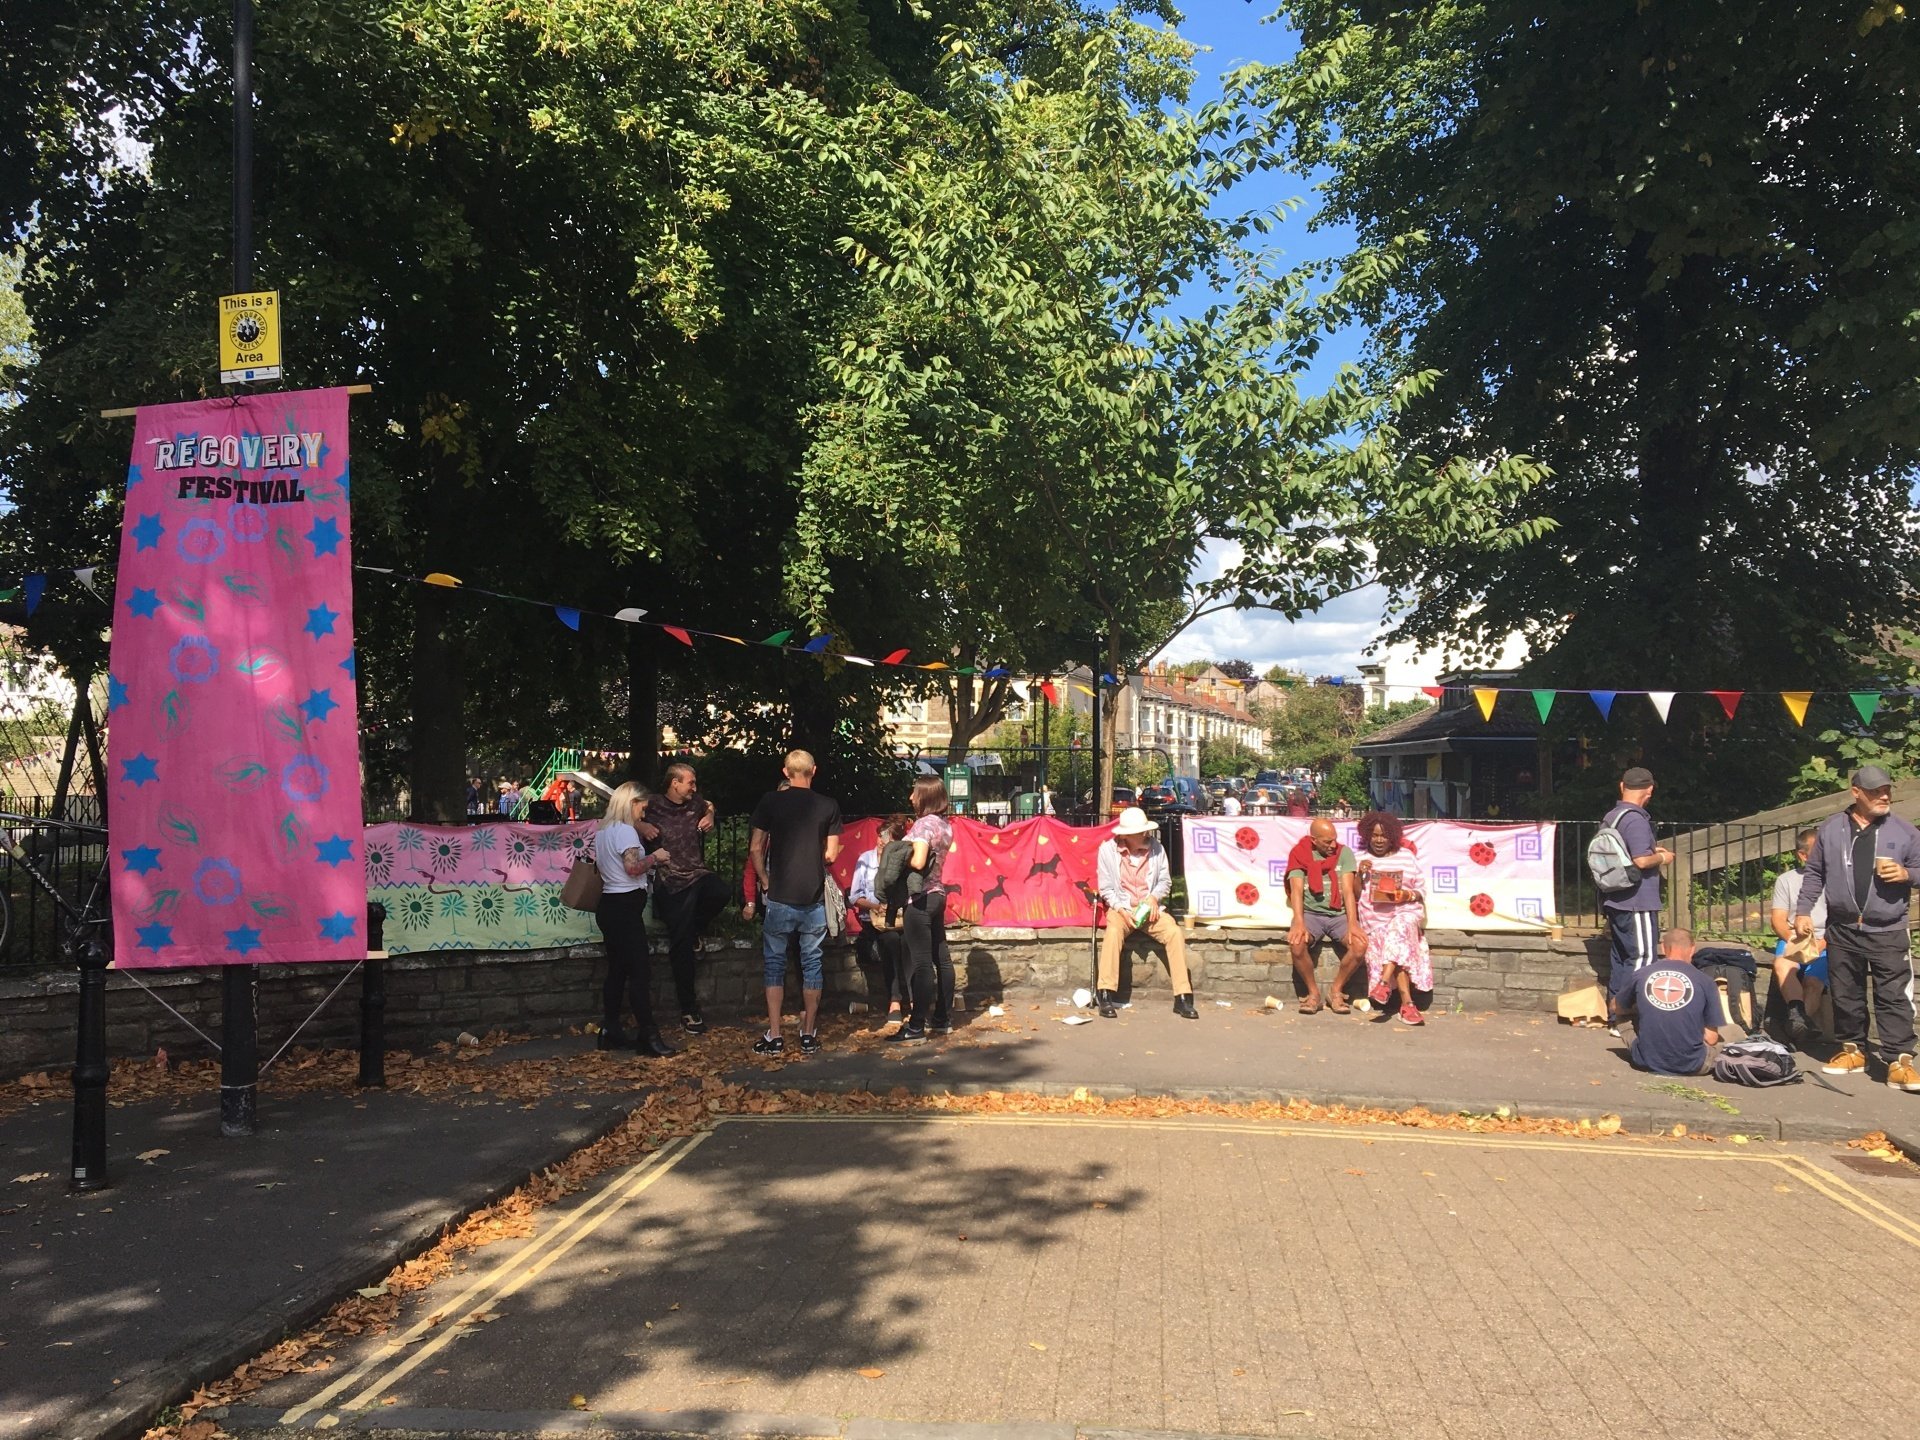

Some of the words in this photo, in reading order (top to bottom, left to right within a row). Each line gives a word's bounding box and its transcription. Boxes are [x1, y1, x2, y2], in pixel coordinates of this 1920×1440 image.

[223, 298, 247, 310] This
[251, 296, 262, 307] is
[266, 296, 273, 306] a
[230, 310, 266, 339] NEIGHBOURHOOD
[238, 340, 260, 351] WATCH
[235, 352, 263, 364] Area
[154, 432, 325, 471] RECOVERY
[178, 475, 305, 505] FESTIVAL
[1648, 971, 1691, 989] SCHWINN
[1648, 994, 1688, 1010] QUALITY
